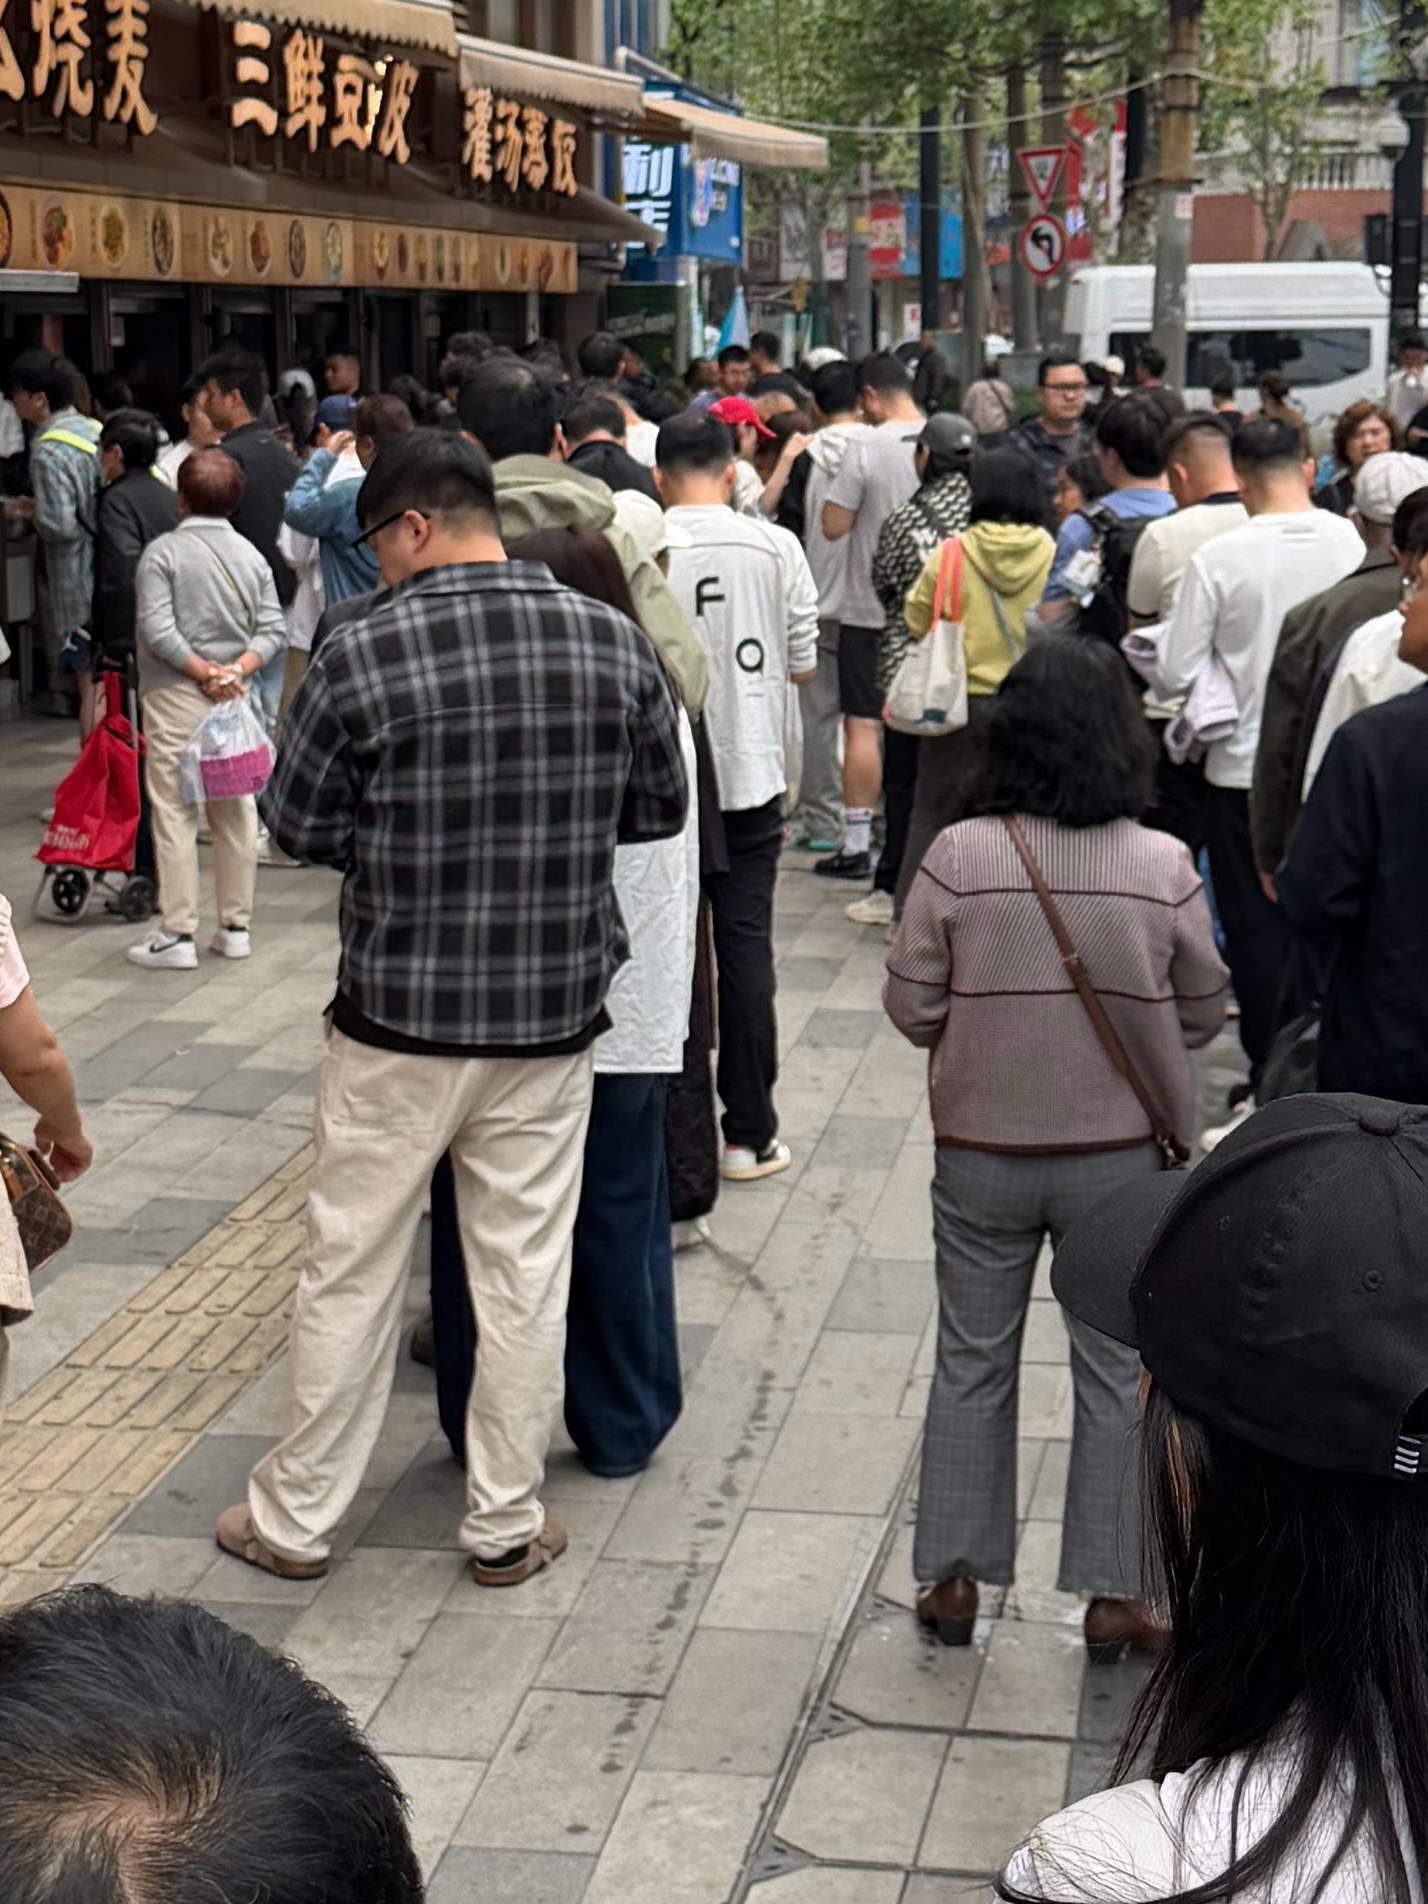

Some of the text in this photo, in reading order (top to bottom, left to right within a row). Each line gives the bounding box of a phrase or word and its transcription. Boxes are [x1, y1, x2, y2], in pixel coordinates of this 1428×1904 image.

[232, 21, 419, 165] 三鲜豆皮
[696, 576, 725, 617] F
